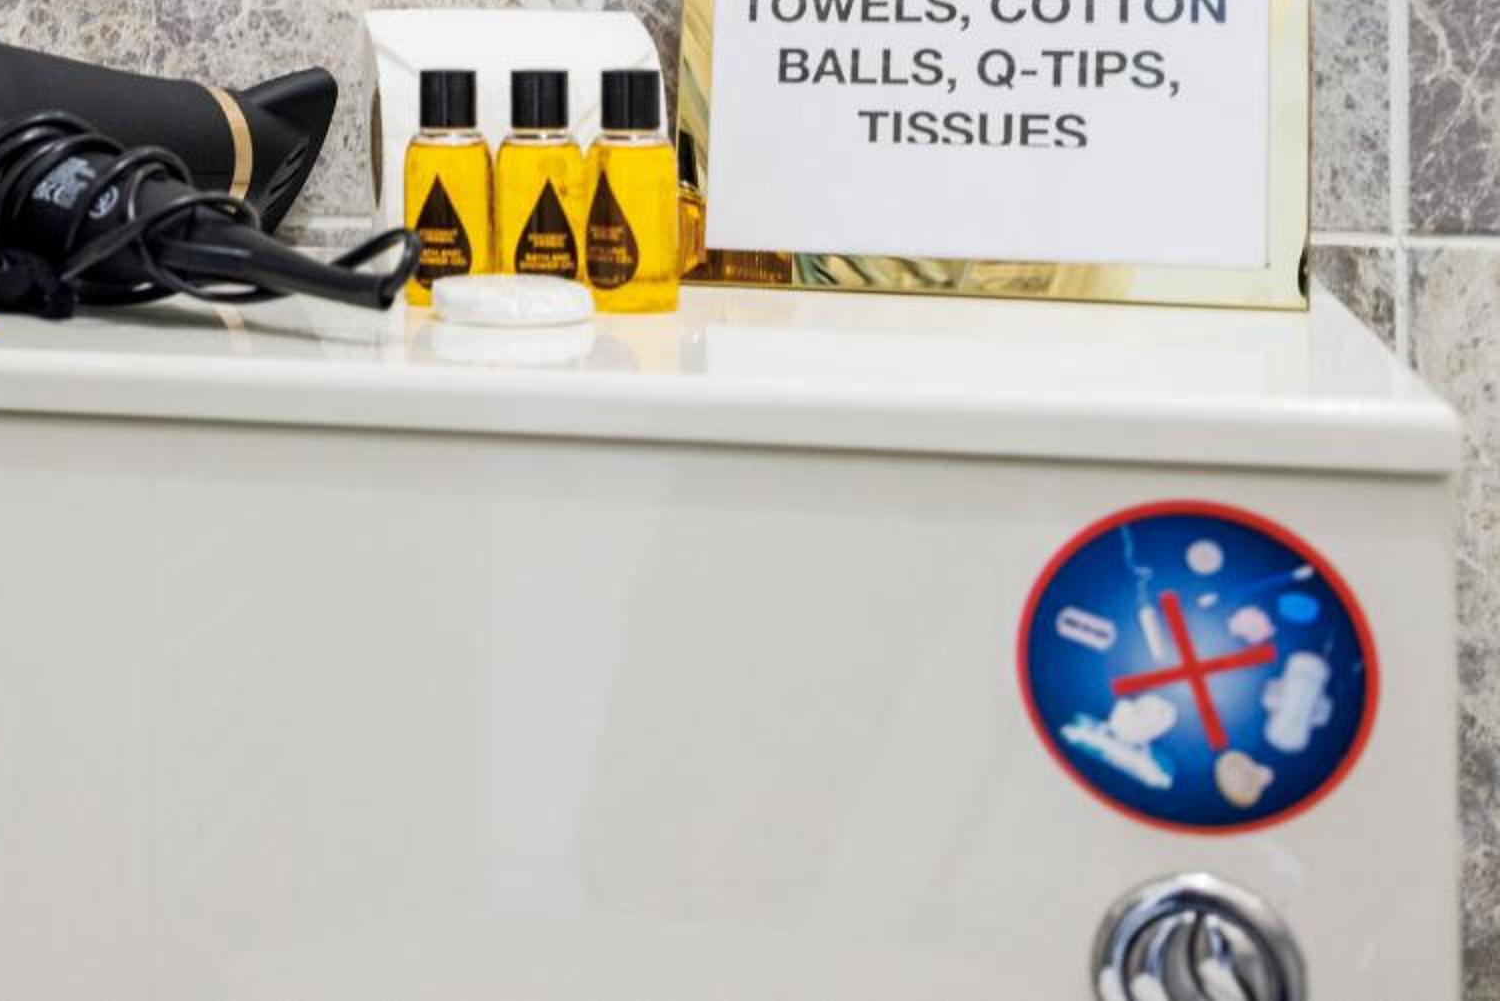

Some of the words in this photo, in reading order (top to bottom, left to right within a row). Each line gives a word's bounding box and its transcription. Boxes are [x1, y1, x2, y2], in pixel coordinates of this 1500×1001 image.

[777, 47, 957, 94] BALLS,
[977, 48, 1179, 97] Q-TIPS,
[857, 110, 1088, 148] TISSUES
